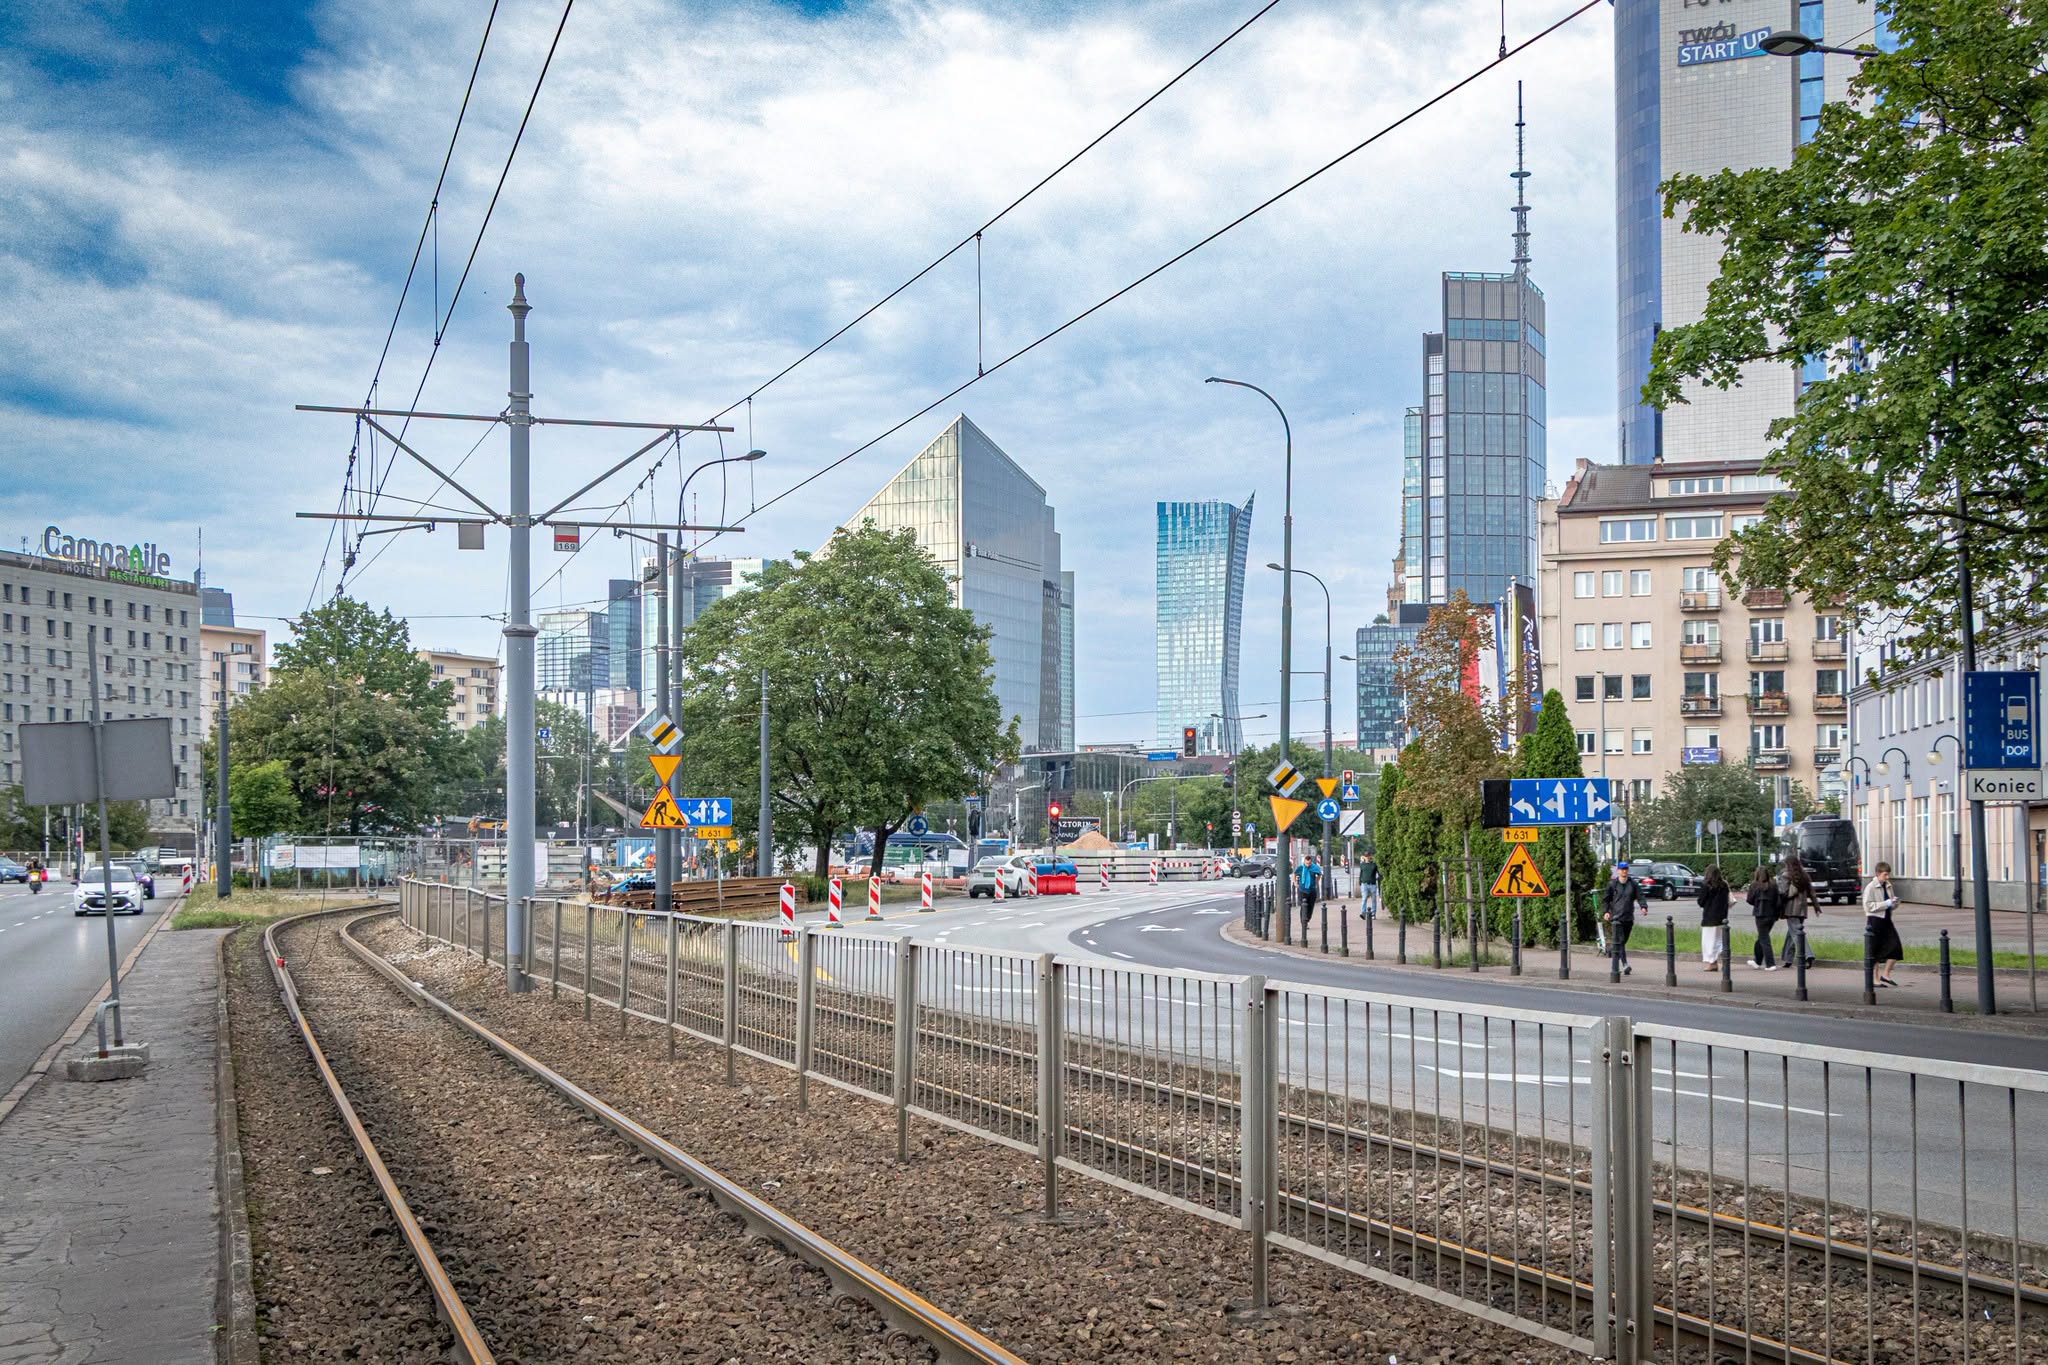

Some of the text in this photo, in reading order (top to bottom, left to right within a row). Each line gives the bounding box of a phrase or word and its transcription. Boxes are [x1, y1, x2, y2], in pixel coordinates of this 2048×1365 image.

[1679, 20, 1736, 45] TWÓJ
[1681, 30, 1770, 63] START UP
[44, 525, 171, 577] Campanile
[65, 561, 97, 577] HOTEL
[109, 570, 169, 588] RESTAURANT
[2006, 729, 2029, 740] BUS
[2006, 745, 2030, 756] DOP
[1974, 778, 2036, 793] Koniec
[707, 830, 720, 838] 631
[1513, 830, 1529, 840] 631
